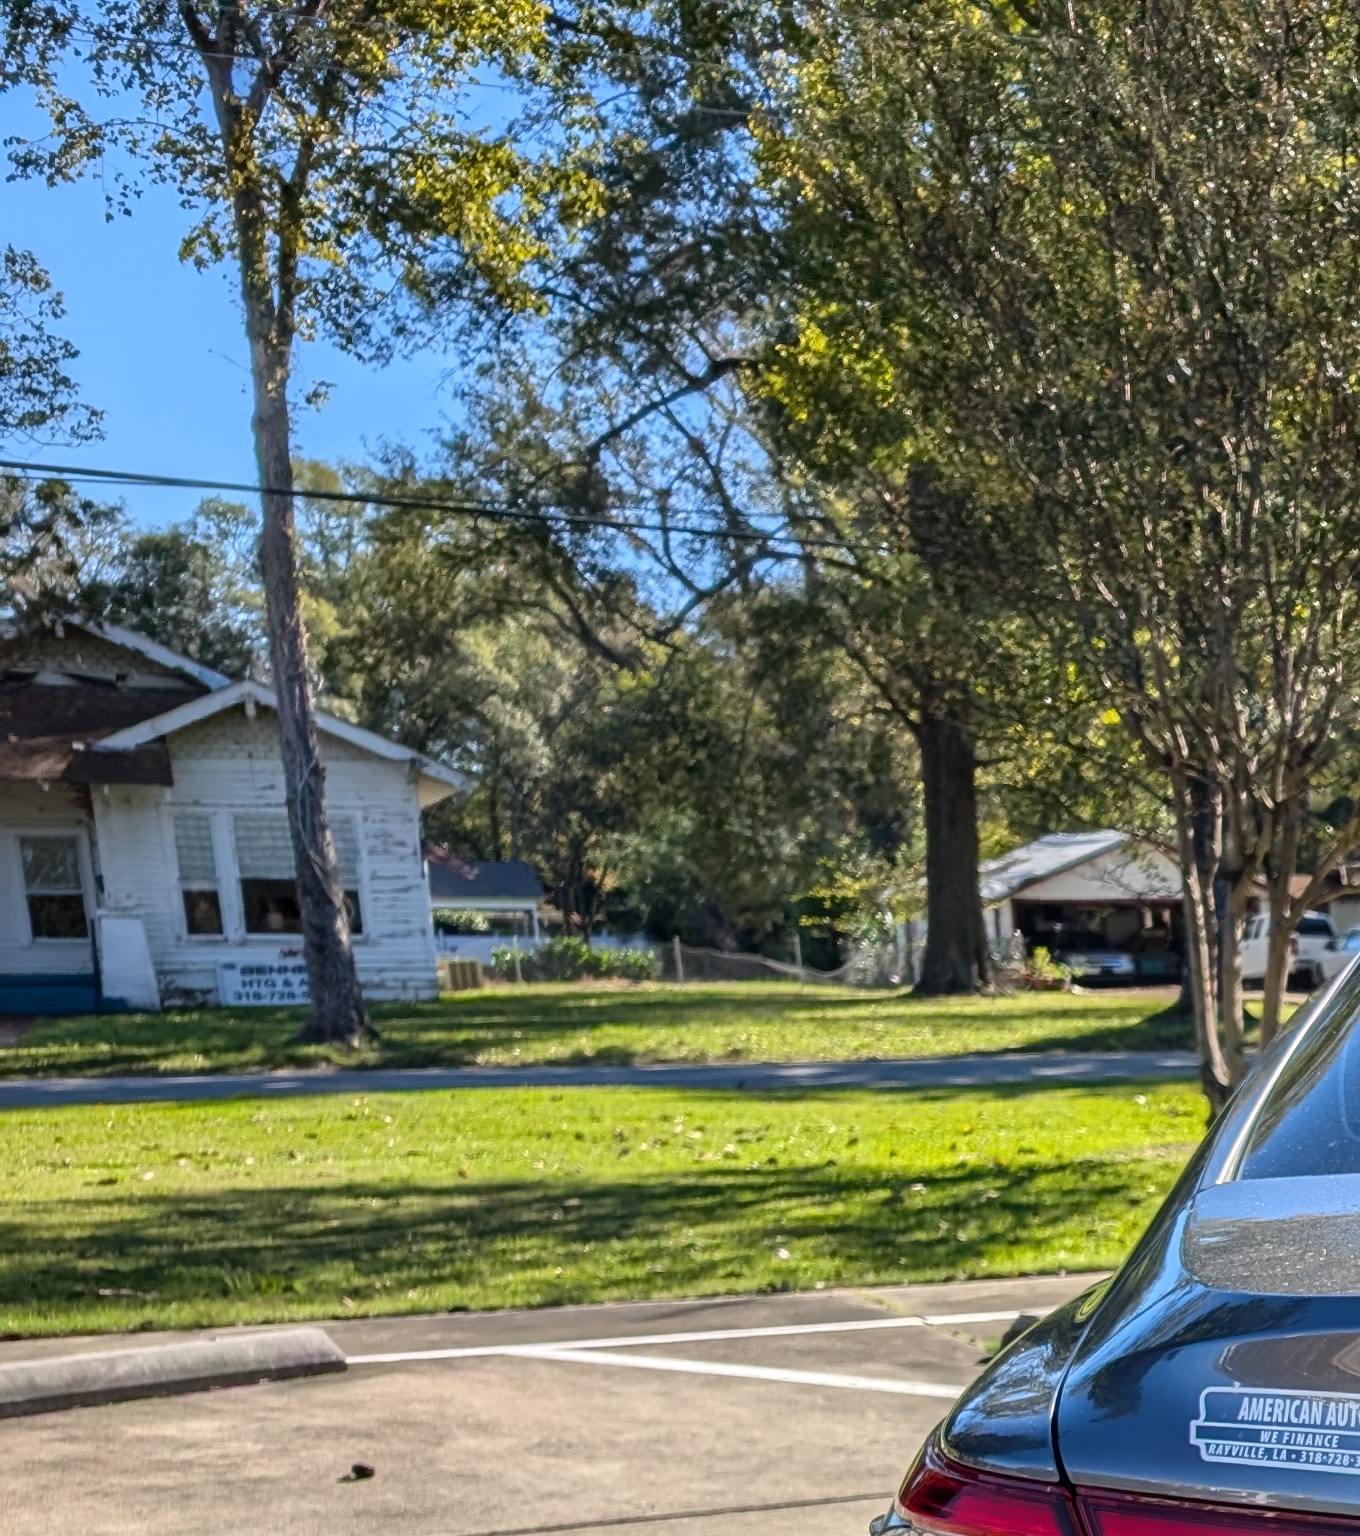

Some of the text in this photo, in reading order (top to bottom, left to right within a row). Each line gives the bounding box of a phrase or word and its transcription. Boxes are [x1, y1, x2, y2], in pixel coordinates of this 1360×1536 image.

[1237, 1397, 1323, 1425] AMERICAN
[1260, 1430, 1339, 1448] WE FINANCE
[1208, 1444, 1268, 1461] RAYVILLE,
[1273, 1450, 1287, 1461] LA
